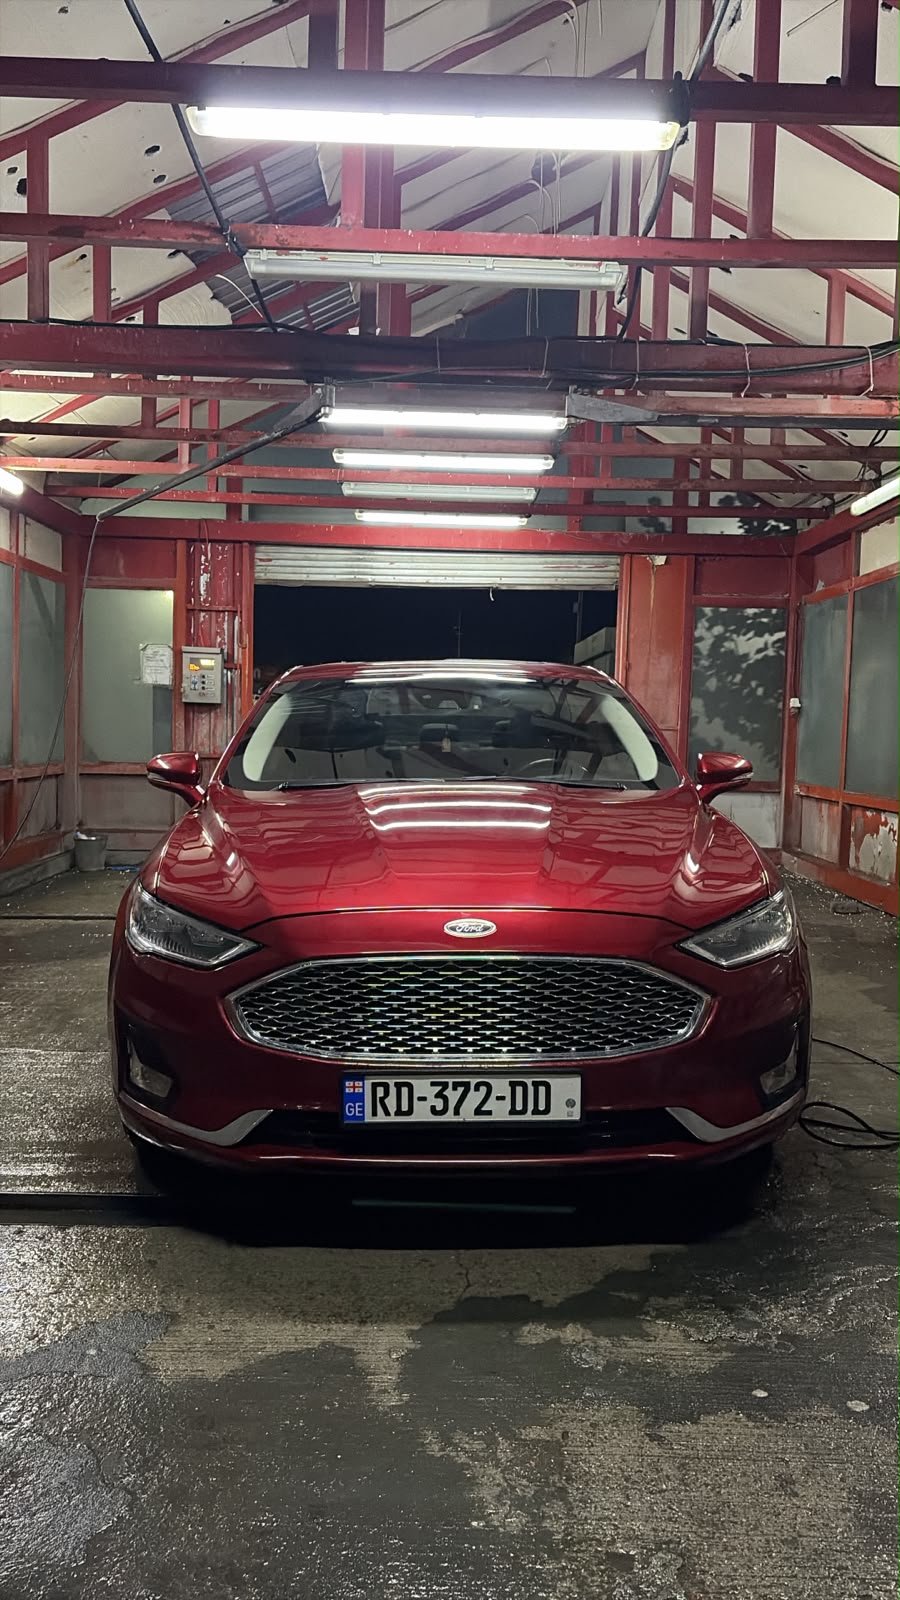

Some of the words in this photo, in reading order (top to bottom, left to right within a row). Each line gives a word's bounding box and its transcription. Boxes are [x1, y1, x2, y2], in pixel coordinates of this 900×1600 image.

[455, 922, 484, 932] Ford
[371, 1080, 552, 1117] RD-372-DD
[345, 1102, 364, 1117] GE
